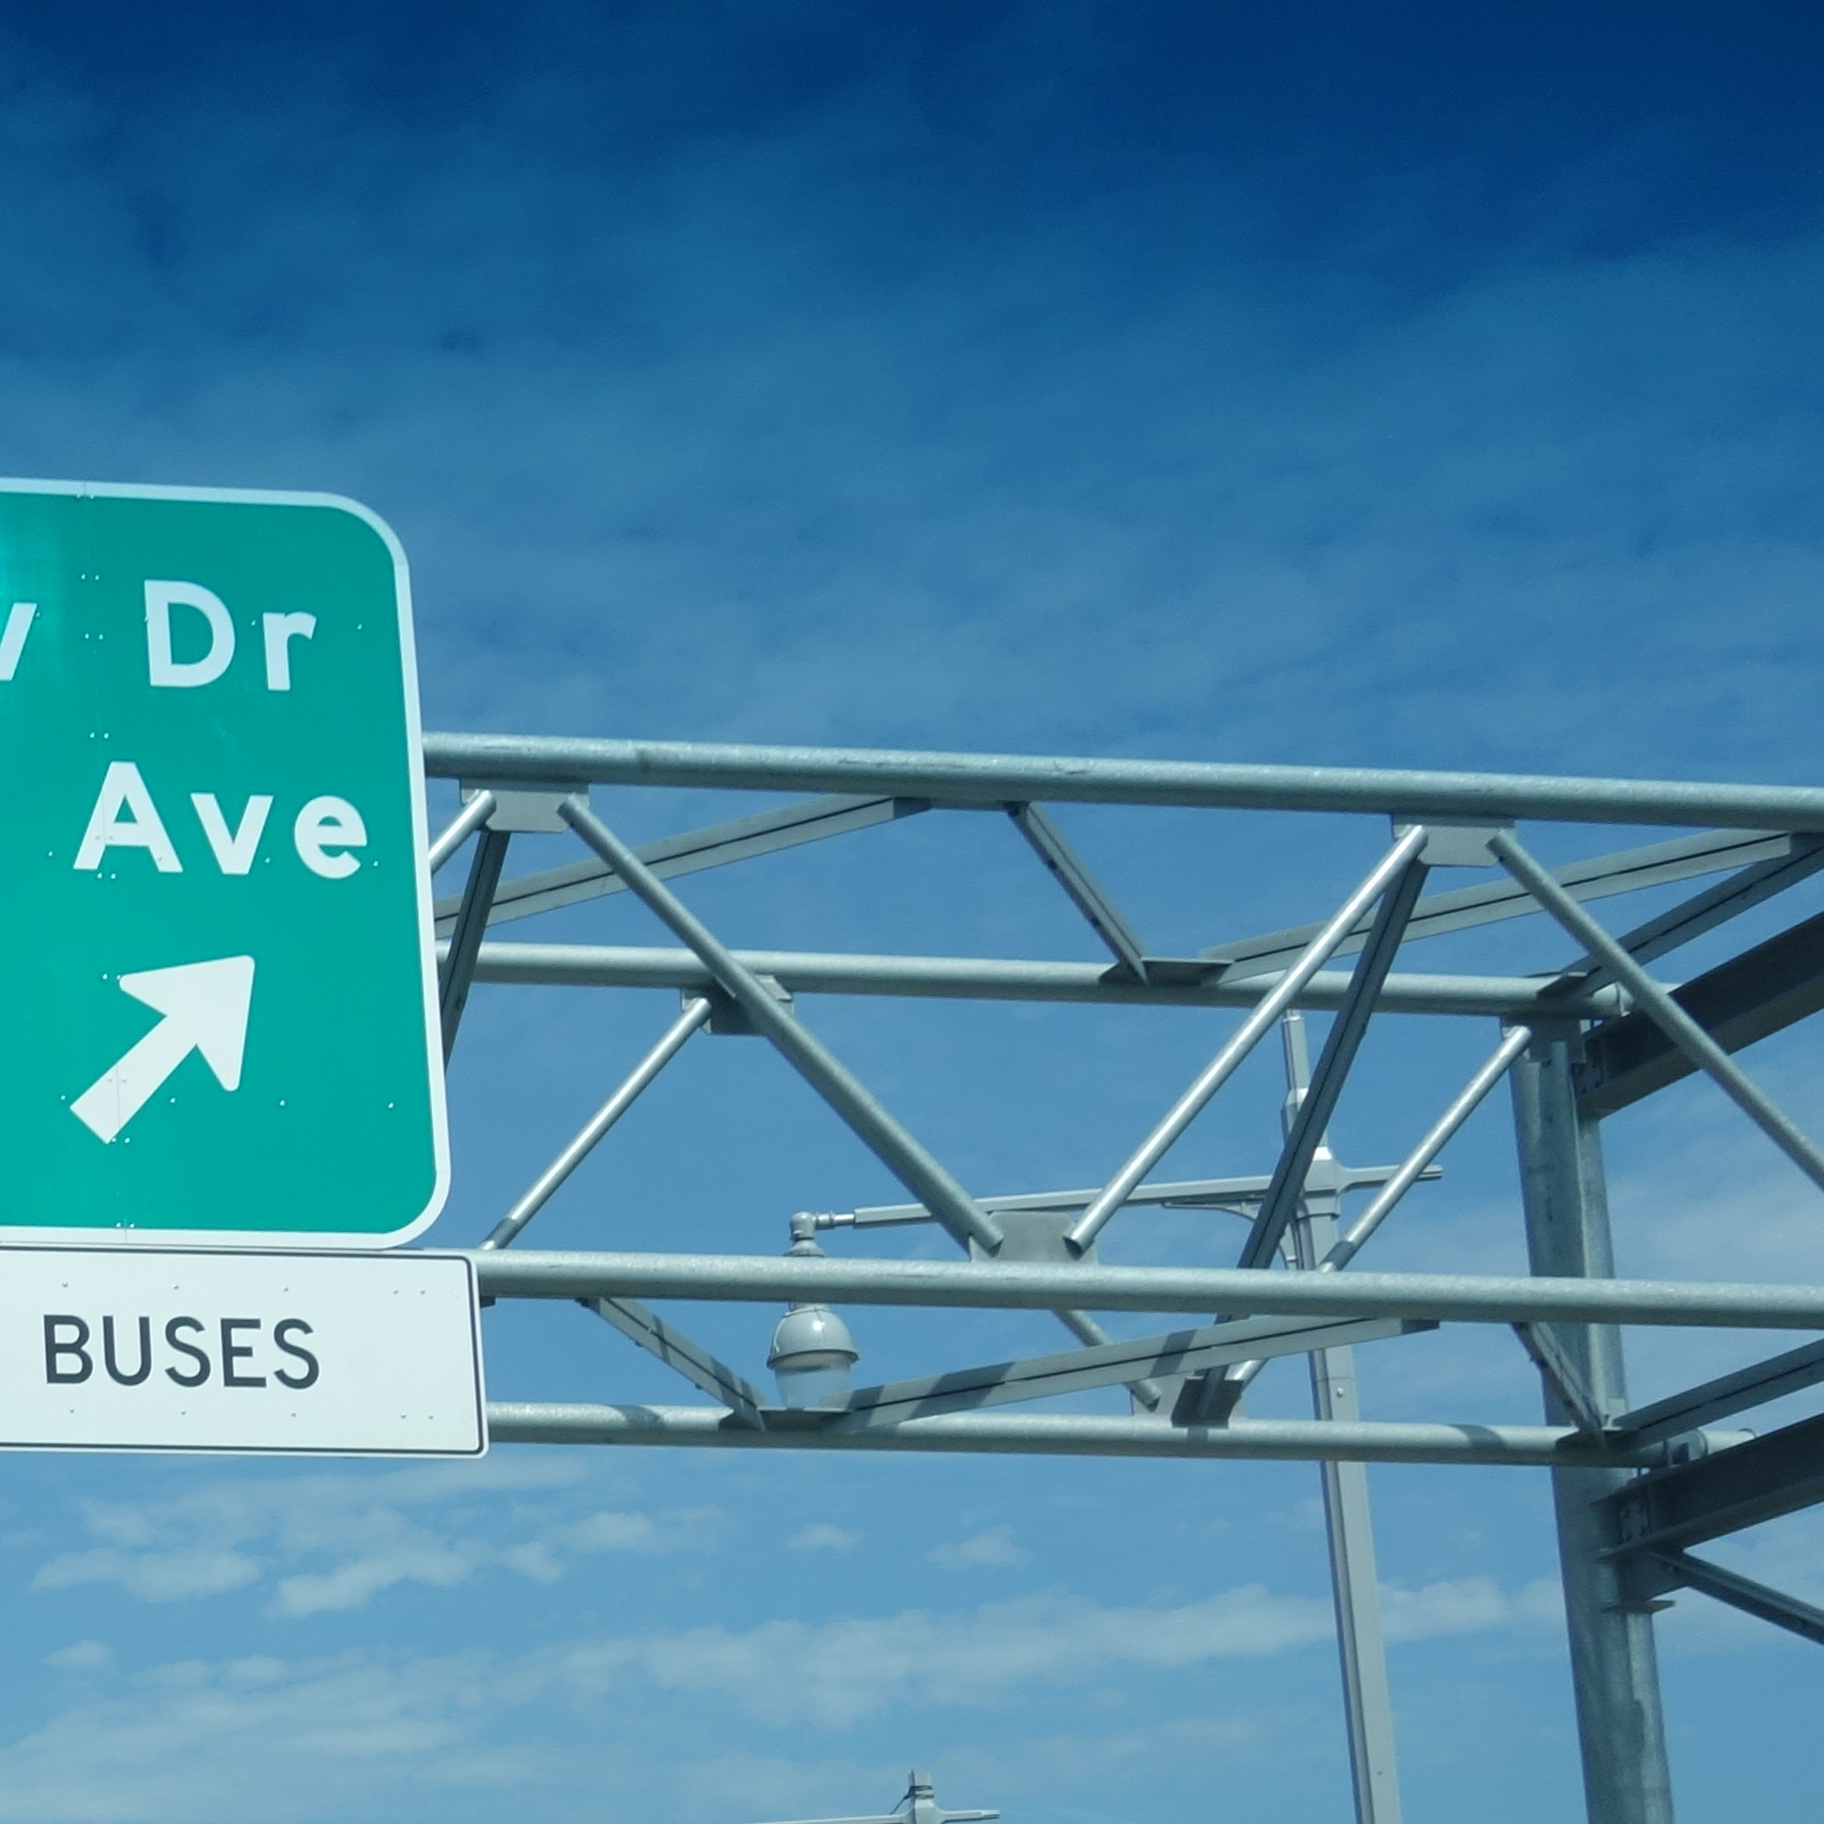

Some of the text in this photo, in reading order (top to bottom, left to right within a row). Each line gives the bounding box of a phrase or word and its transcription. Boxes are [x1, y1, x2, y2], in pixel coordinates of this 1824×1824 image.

[145, 580, 316, 690] Dr
[74, 762, 367, 878] Ave
[44, 1315, 319, 1389] BUSES
